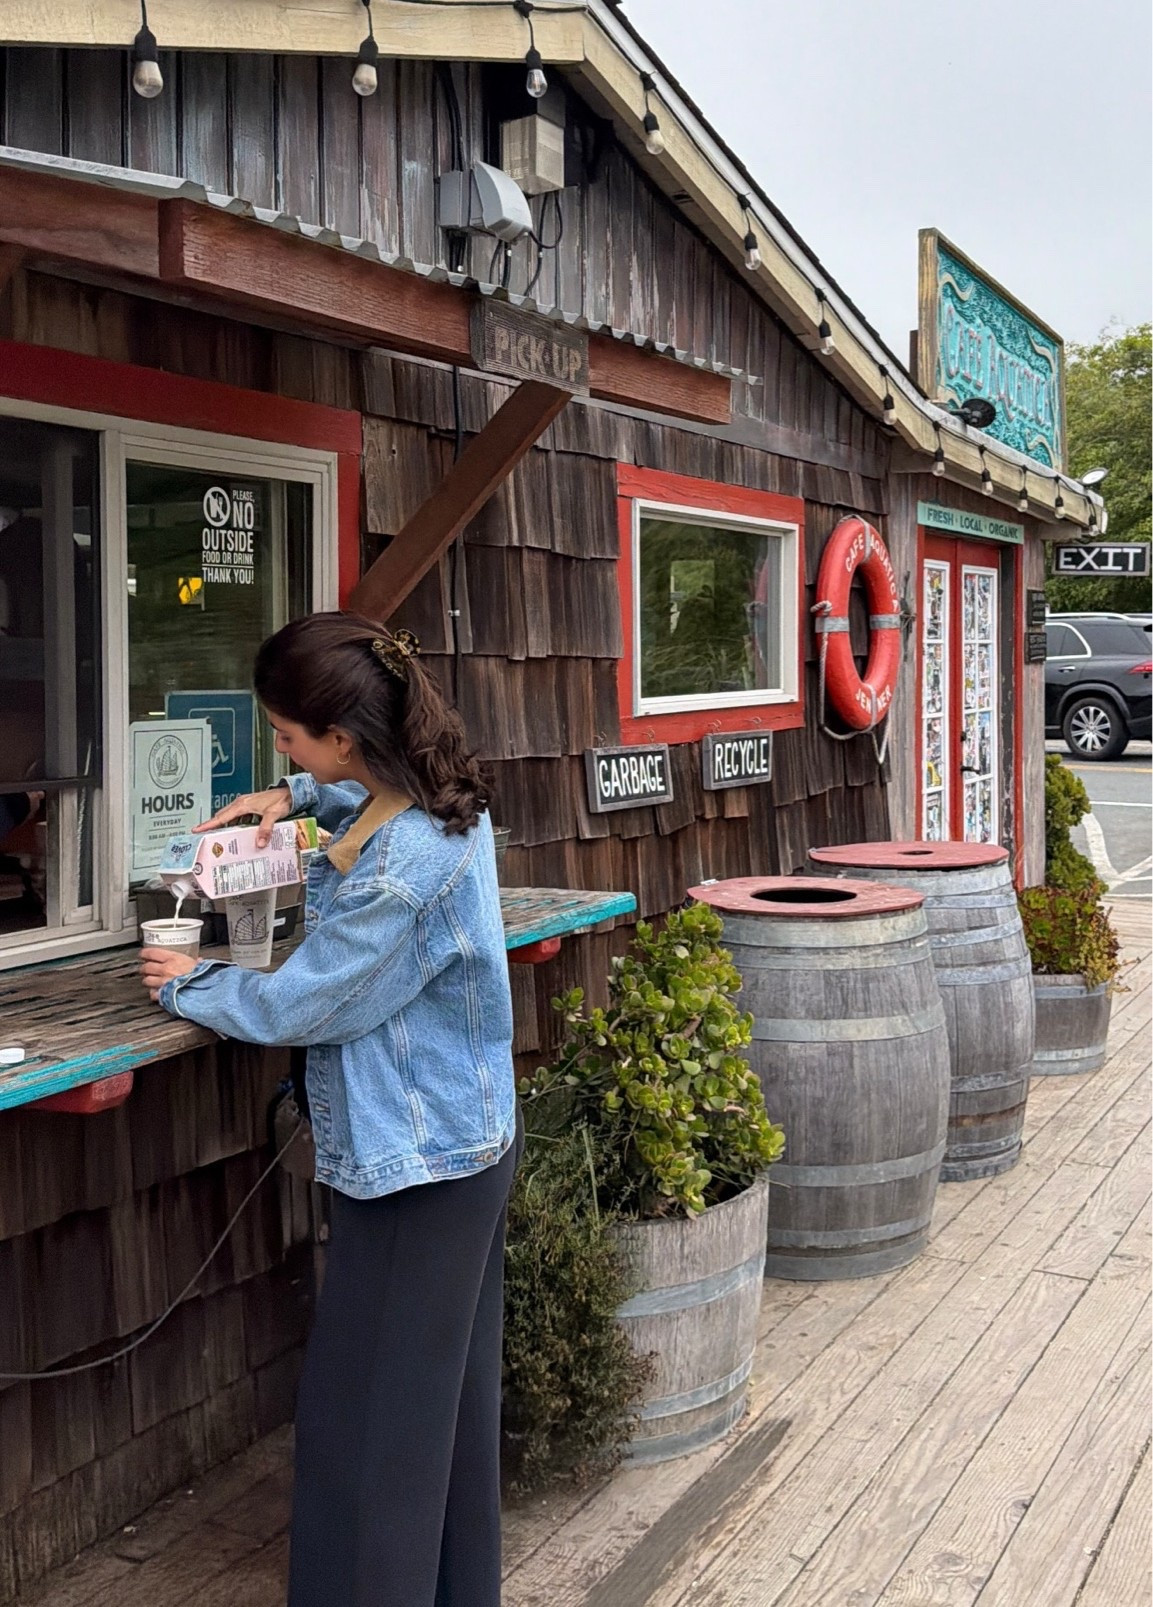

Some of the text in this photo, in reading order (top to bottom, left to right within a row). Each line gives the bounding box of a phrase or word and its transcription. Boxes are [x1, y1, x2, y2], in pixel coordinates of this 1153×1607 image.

[495, 326, 582, 382] PICK UP
[233, 501, 254, 529] NO
[927, 508, 1019, 539] FRESH LOCAL ORGANIC
[202, 528, 254, 552] OUTSIDE
[845, 533, 864, 573] CAFE
[202, 551, 254, 566] FOOD OR DRINK
[1059, 548, 1142, 571] EXIT
[202, 567, 255, 585] THANK YOU!
[714, 739, 768, 780] RECYCLE
[599, 755, 665, 798] GARBAGE
[141, 793, 194, 814] HOURS
[153, 818, 182, 827] EVERYDAY
